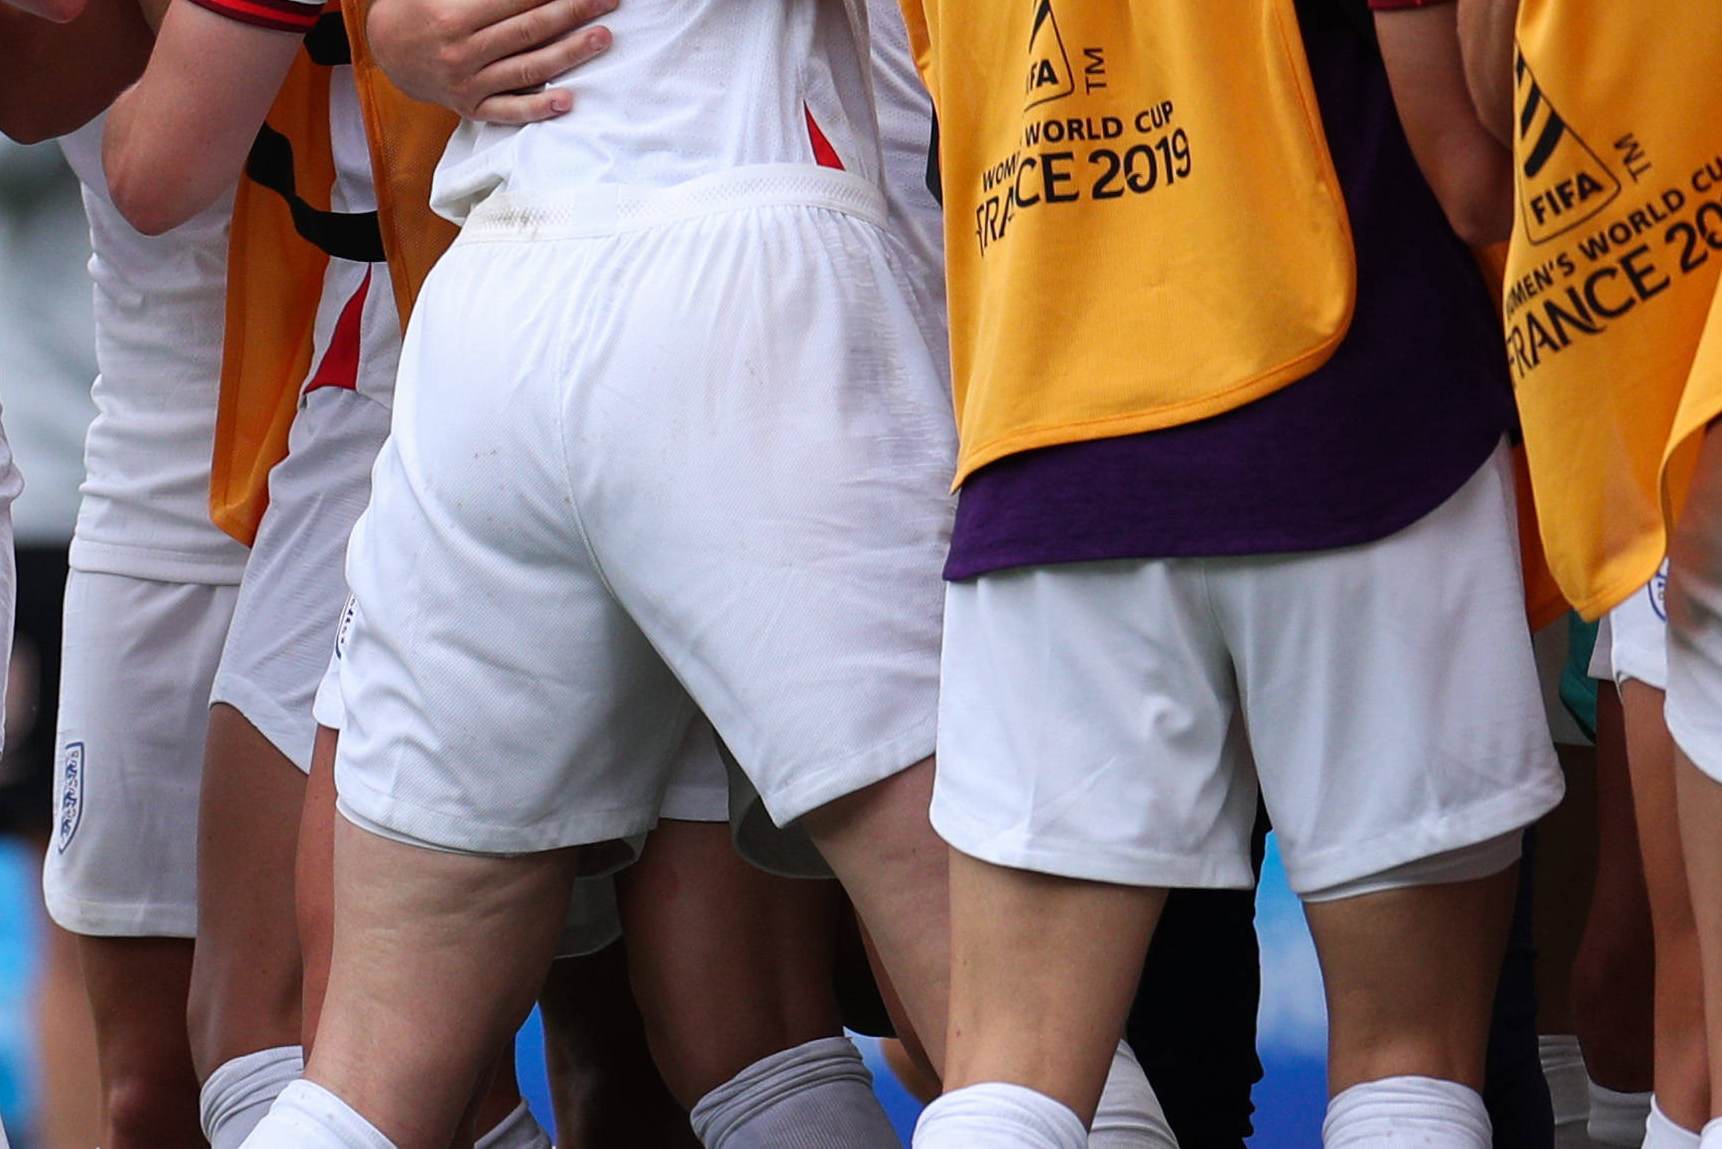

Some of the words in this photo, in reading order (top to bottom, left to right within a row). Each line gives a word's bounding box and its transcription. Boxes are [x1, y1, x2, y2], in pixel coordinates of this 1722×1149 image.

[1084, 47, 1107, 96] TM
[1025, 116, 1124, 147] WORLD
[1134, 100, 1174, 134] CUP
[1088, 127, 1192, 201] 2019
[1613, 132, 1654, 184] TM
[1530, 172, 1604, 227] FIFA
[1507, 251, 1577, 322] MEN'S
[1578, 188, 1686, 262] WORLD
[1691, 154, 1722, 193] CU
[1664, 200, 1722, 275] 20
